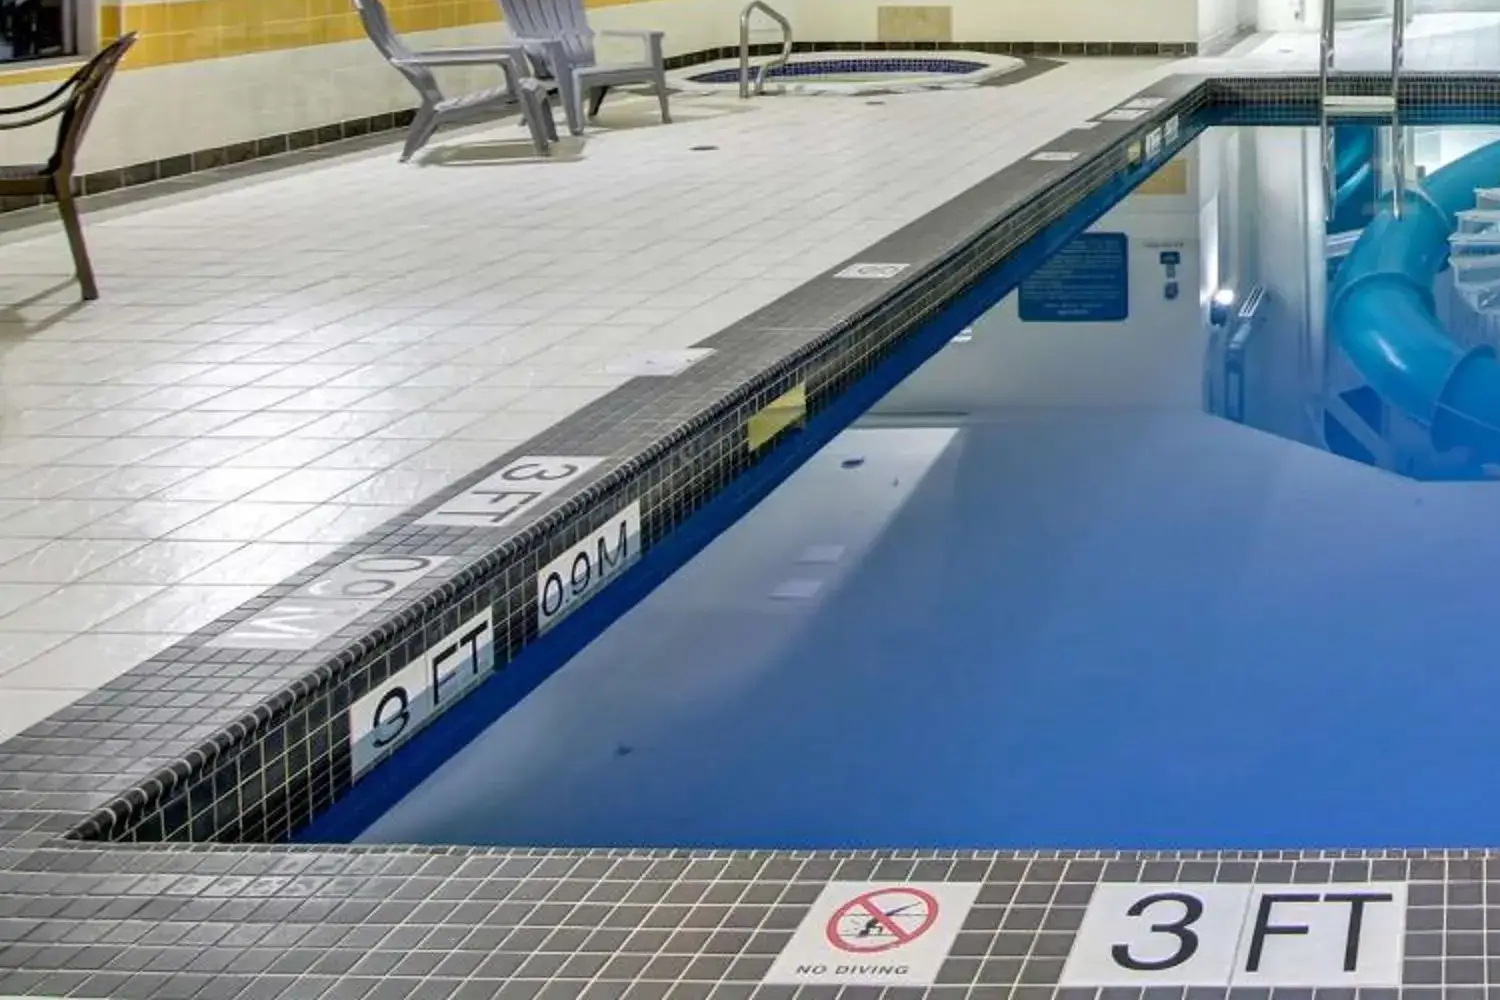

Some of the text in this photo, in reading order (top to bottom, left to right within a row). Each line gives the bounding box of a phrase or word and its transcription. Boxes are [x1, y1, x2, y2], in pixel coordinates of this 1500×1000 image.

[436, 463, 578, 522] 3 FT
[432, 620, 488, 705] FT
[1111, 892, 1393, 972] 3 FT
[796, 964, 910, 975] NO DIVING
